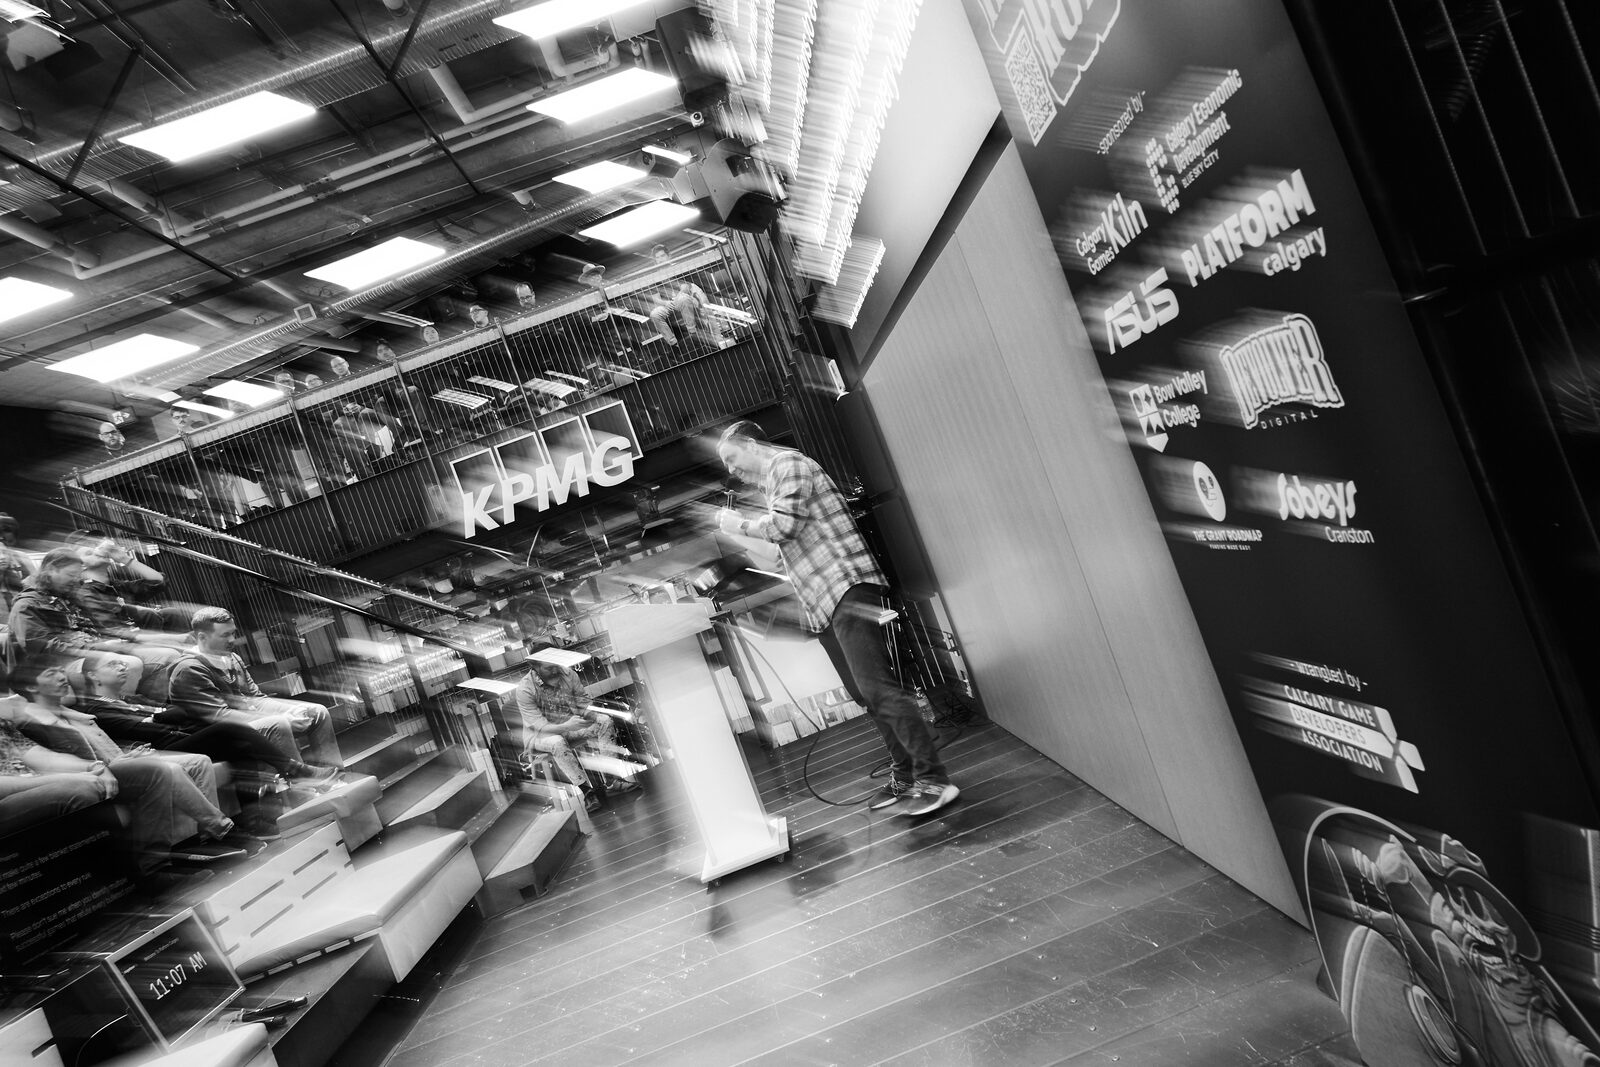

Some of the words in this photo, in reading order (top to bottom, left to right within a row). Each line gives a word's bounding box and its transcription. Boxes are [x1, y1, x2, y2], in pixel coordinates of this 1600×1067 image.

[1165, 112, 1197, 153] Calgary
[1192, 69, 1243, 125] Economic
[1173, 111, 1231, 174] Development
[1181, 170, 1195, 189] BLUE
[1192, 161, 1205, 179] SKY
[1203, 148, 1220, 169] CITY
[1076, 222, 1107, 257] Calgary
[1101, 192, 1149, 254] Kiln
[1181, 168, 1316, 288] PLATFORM
[1087, 245, 1116, 276] Games
[1262, 226, 1327, 277] calgary
[1104, 266, 1179, 355] ASUS
[1152, 382, 1175, 404] Bow
[1172, 370, 1208, 401] Valley
[1220, 313, 1345, 429] DEVOLVER
[1162, 402, 1201, 429] College
[1261, 409, 1319, 430] DIGITAL
[462, 435, 635, 540] KPMG
[1277, 471, 1357, 526] Sobeys
[1192, 530, 1206, 541] THE
[1205, 530, 1227, 541] GRANT
[1226, 529, 1263, 541] ROADMAP
[1325, 525, 1375, 544] Cranston
[1284, 685, 1335, 714] CALGARY
[1338, 700, 1376, 727] GAME
[1293, 707, 1366, 744] DEVELOPERS
[1301, 728, 1384, 774] ASSOCIATION
[149, 963, 187, 1000] 11:07
[189, 951, 207, 973] AM
